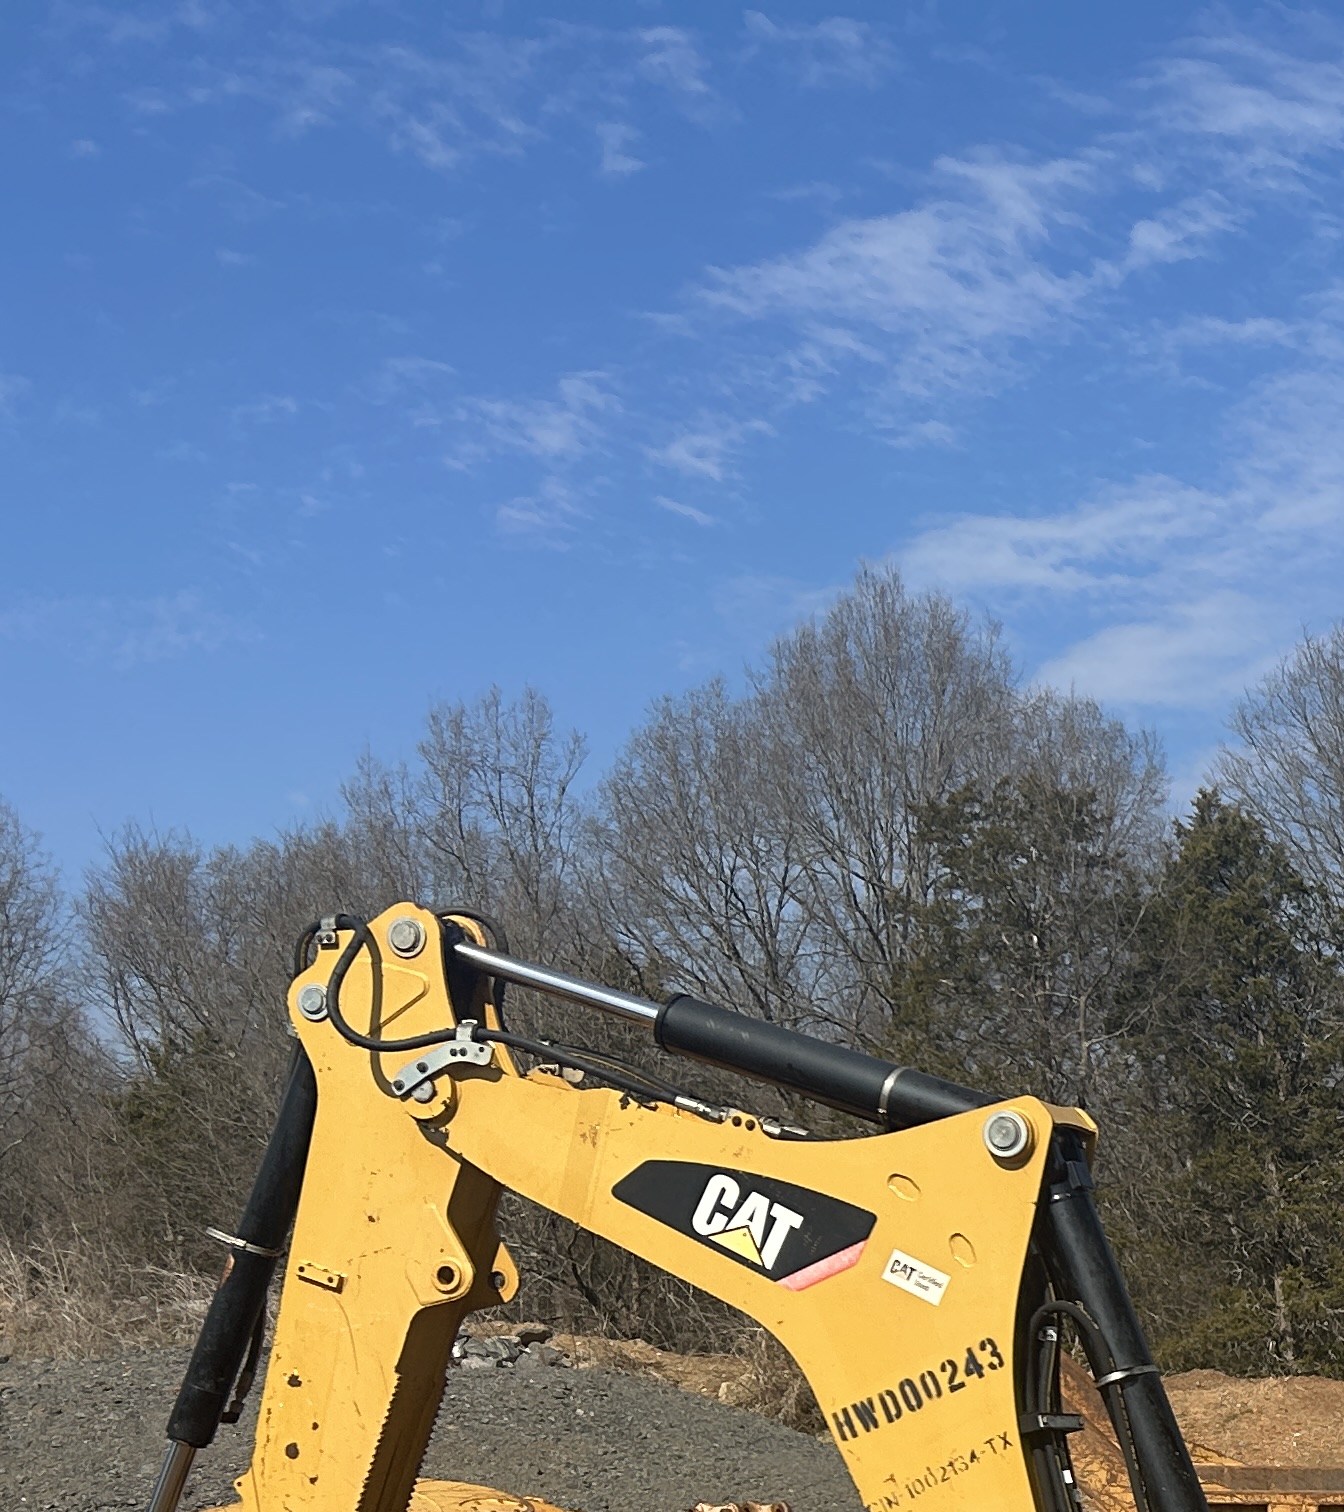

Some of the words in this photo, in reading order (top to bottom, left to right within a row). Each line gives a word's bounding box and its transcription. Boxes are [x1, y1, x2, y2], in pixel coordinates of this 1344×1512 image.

[692, 1173, 804, 1270] CAT
[890, 1259, 918, 1281] CAT
[831, 1337, 1005, 1441] HWD00243
